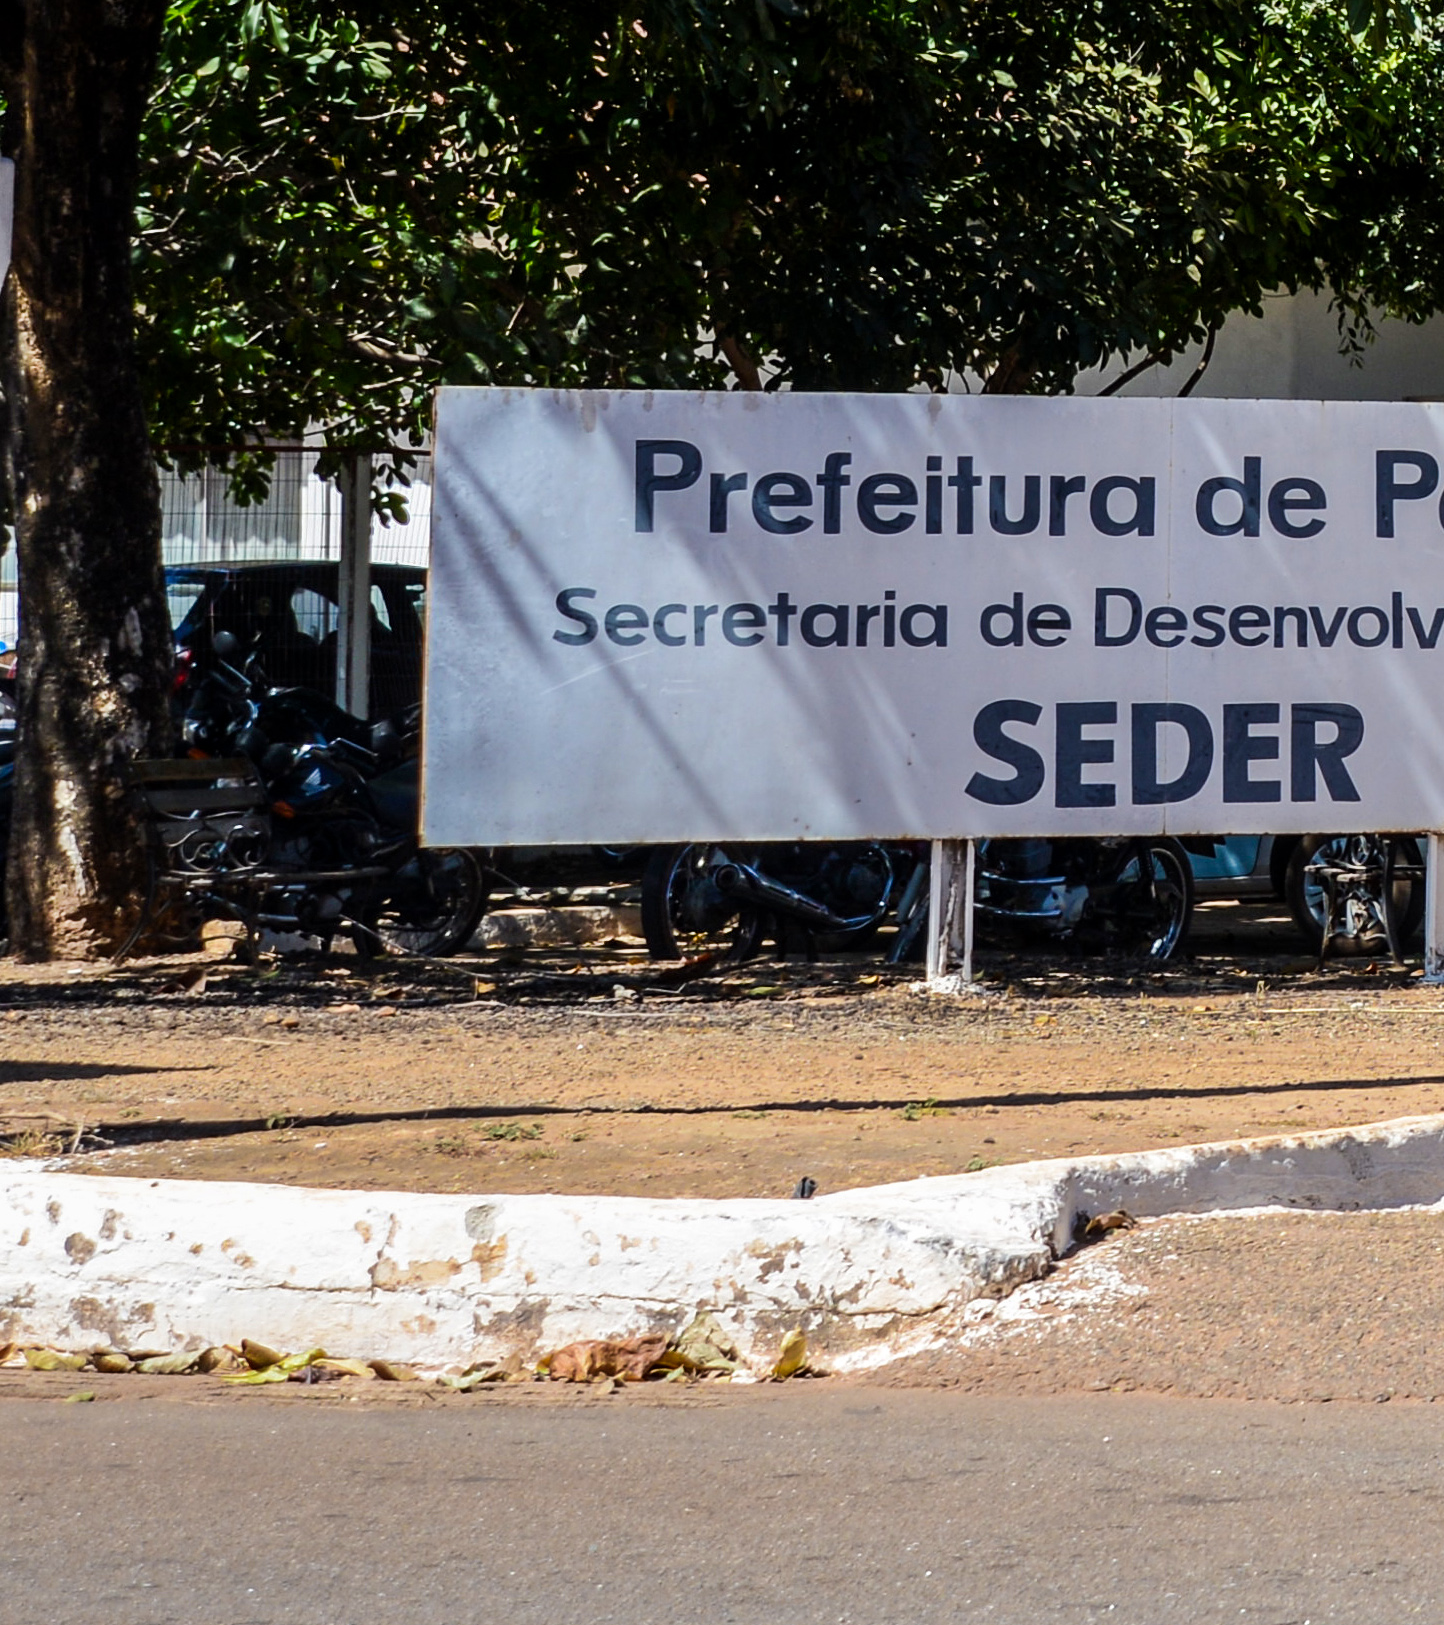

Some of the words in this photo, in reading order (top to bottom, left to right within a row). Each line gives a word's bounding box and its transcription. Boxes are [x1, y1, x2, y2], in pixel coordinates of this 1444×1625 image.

[634, 438, 1156, 538] Prefeitura
[1195, 455, 1327, 540] de
[551, 587, 948, 649] Secretaria
[979, 590, 1072, 649] de
[963, 698, 1366, 810] SEDER
